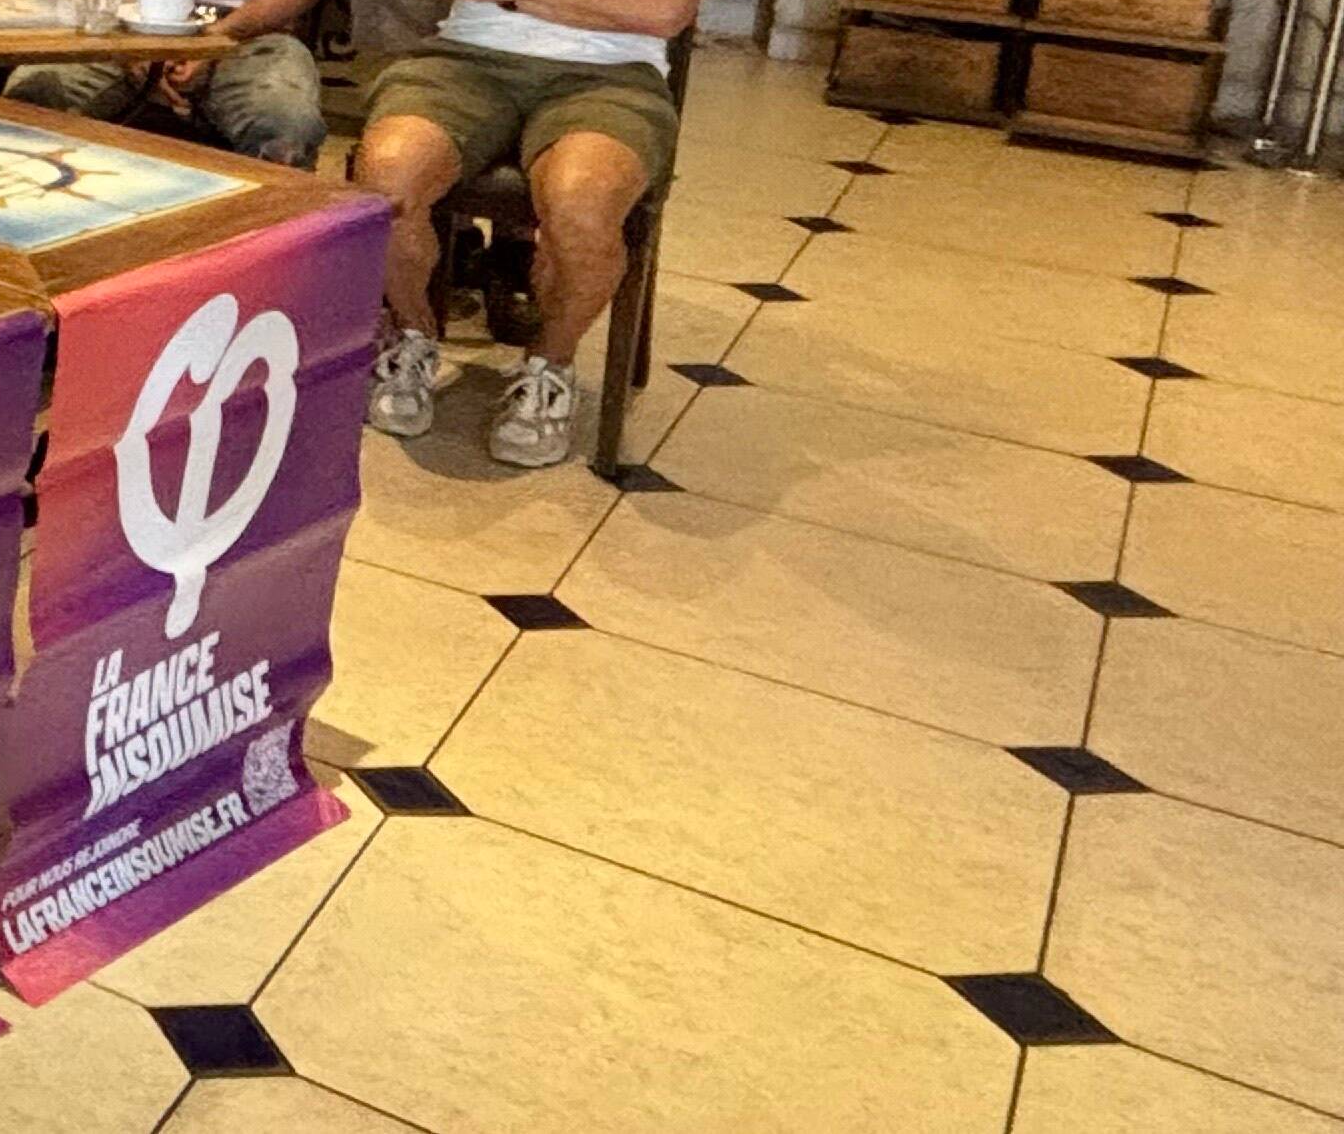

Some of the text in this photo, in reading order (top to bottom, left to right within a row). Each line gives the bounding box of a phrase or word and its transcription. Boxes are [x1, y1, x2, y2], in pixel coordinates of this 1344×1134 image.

[85, 631, 220, 775] FRANCE
[91, 649, 123, 698] LA
[2, 792, 250, 955] LAFRANCEINSOUMISE.FR
